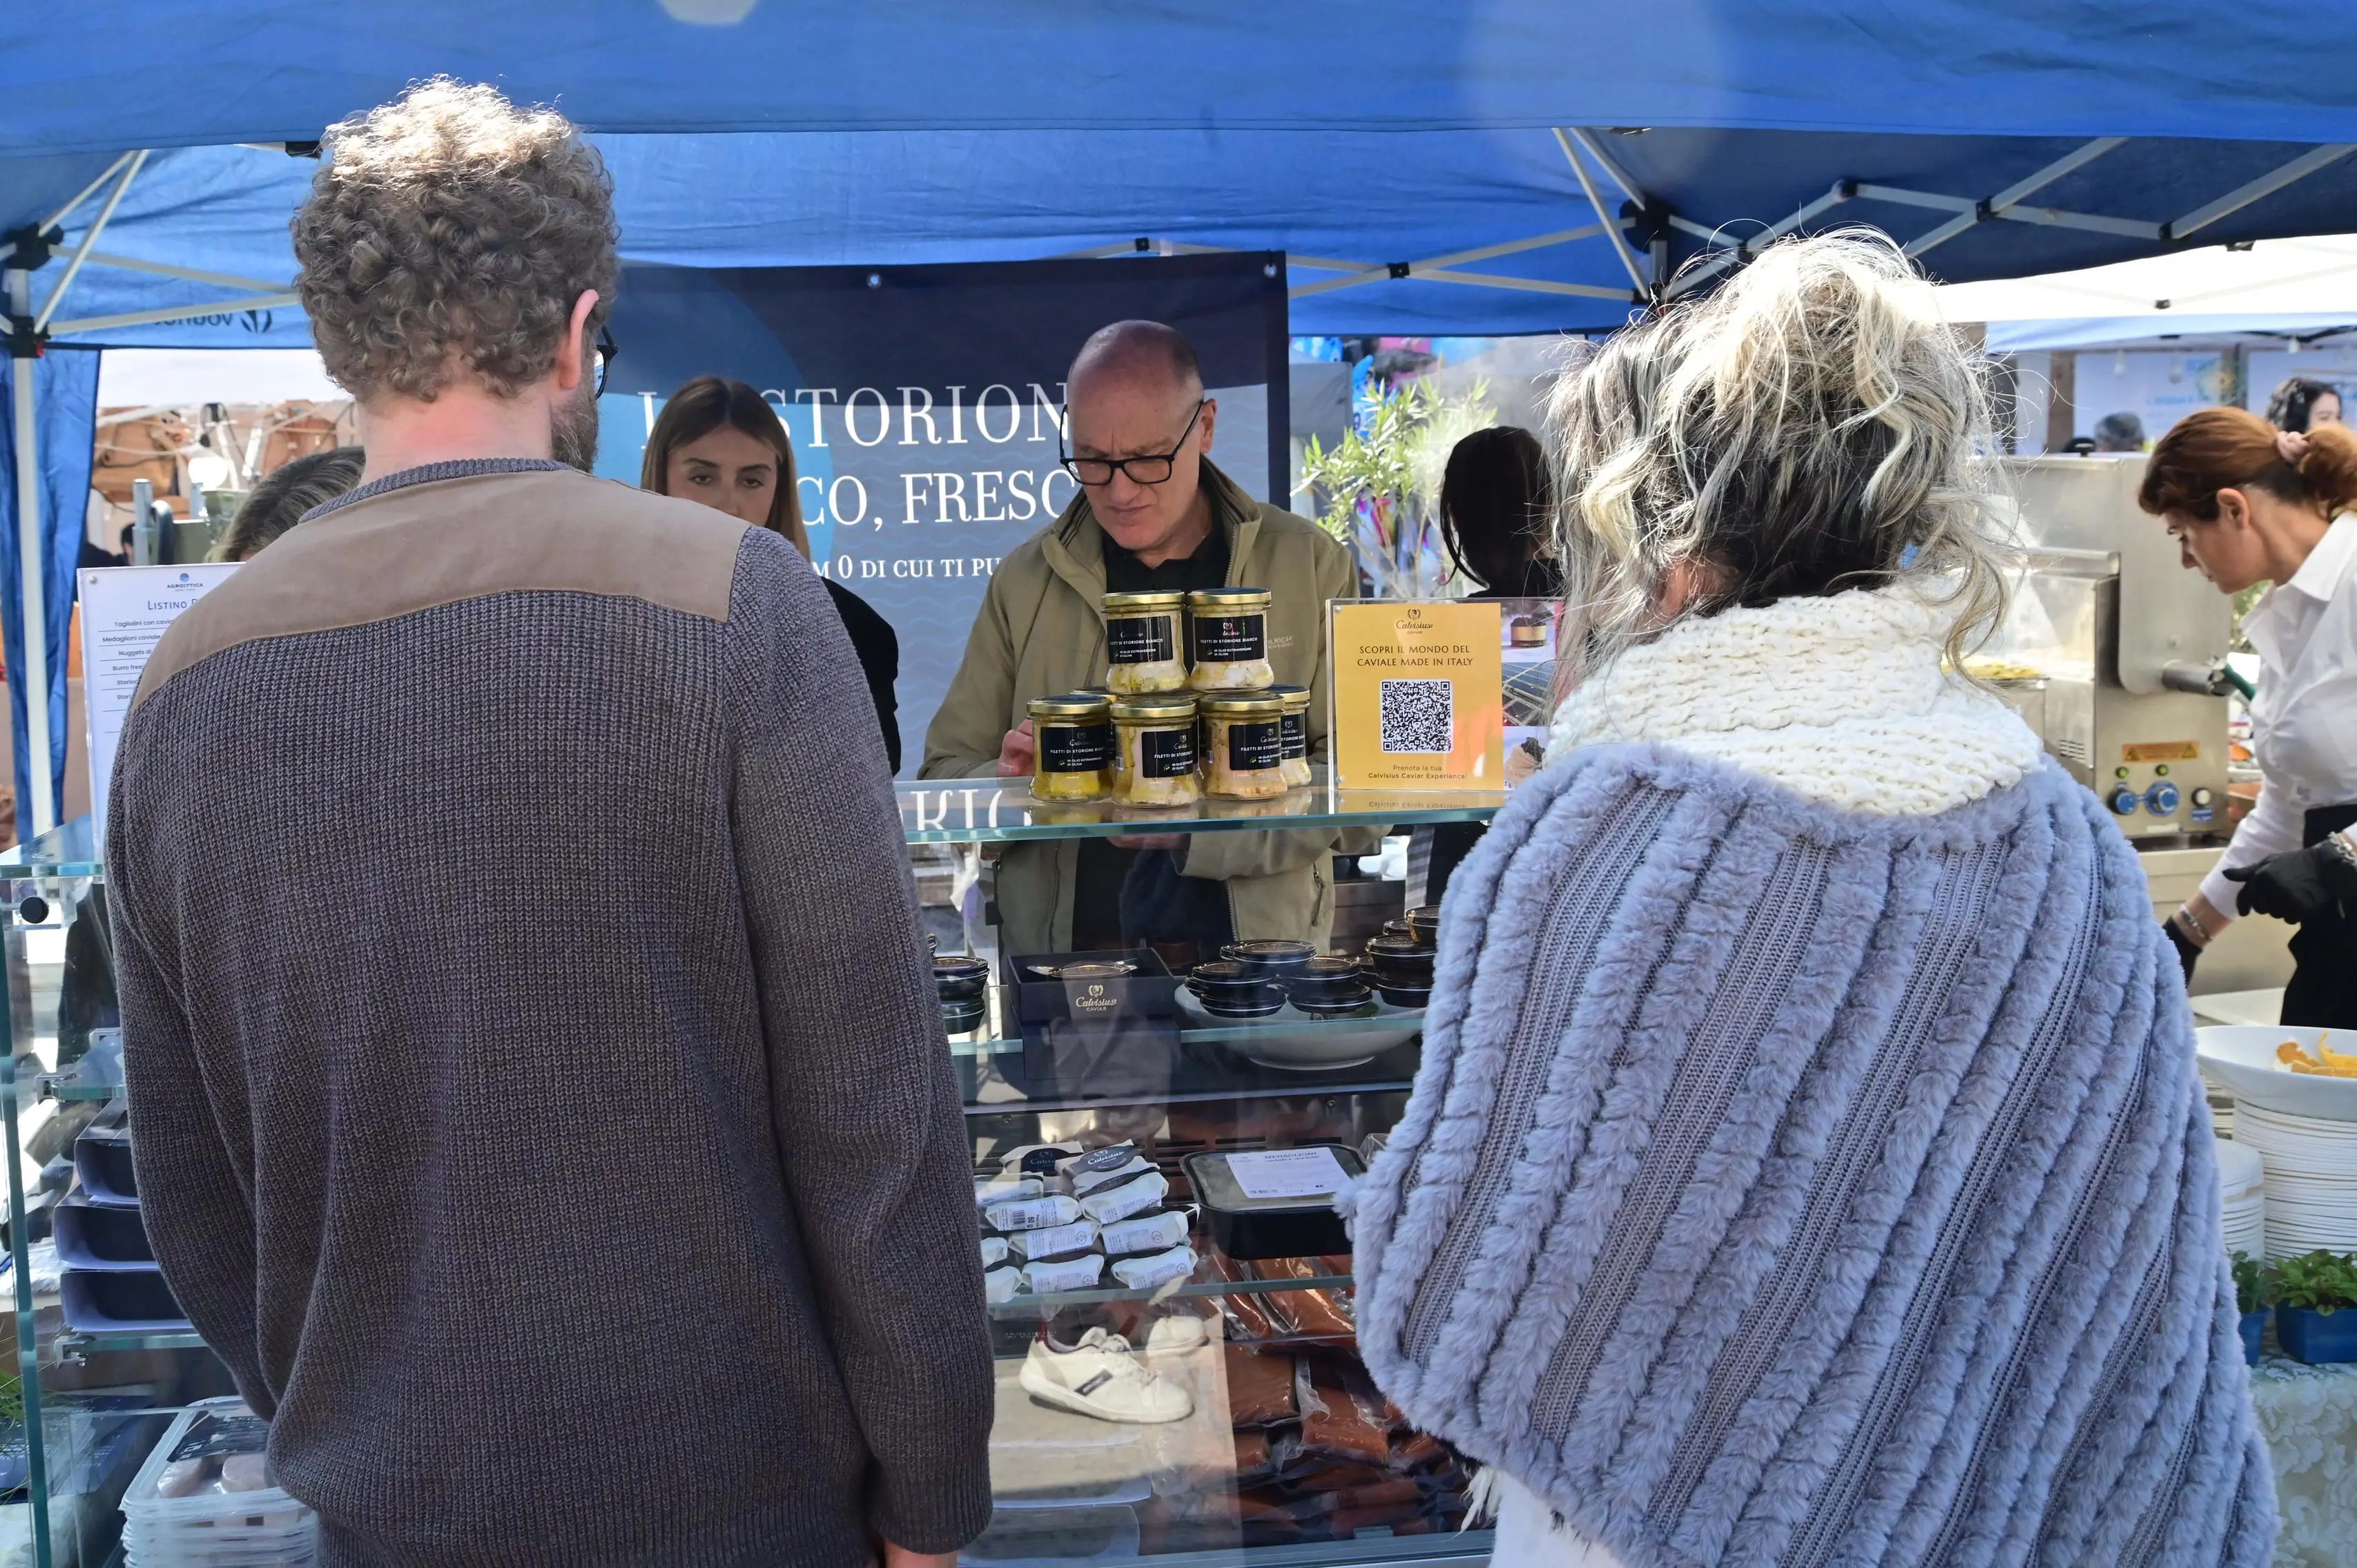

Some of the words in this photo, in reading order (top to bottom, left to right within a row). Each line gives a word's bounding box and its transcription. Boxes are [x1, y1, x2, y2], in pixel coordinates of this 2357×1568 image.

[860, 559, 886, 579] DI
[893, 559, 933, 578] CUI
[940, 559, 965, 577] TI
[115, 619, 142, 628] Tagliolini
[1395, 619, 1433, 630] Calvisius
[1359, 646, 1393, 654] SCOPRI
[1397, 646, 1405, 654] IL
[1408, 645, 1449, 654] MONDO
[1453, 645, 1470, 653] DEL
[1357, 658, 1397, 666] CAVIALE
[1400, 658, 1429, 666] MADE
[1433, 658, 1443, 666] IN
[1447, 657, 1473, 666] ITALY
[1076, 996, 1117, 1007] Calvisius
